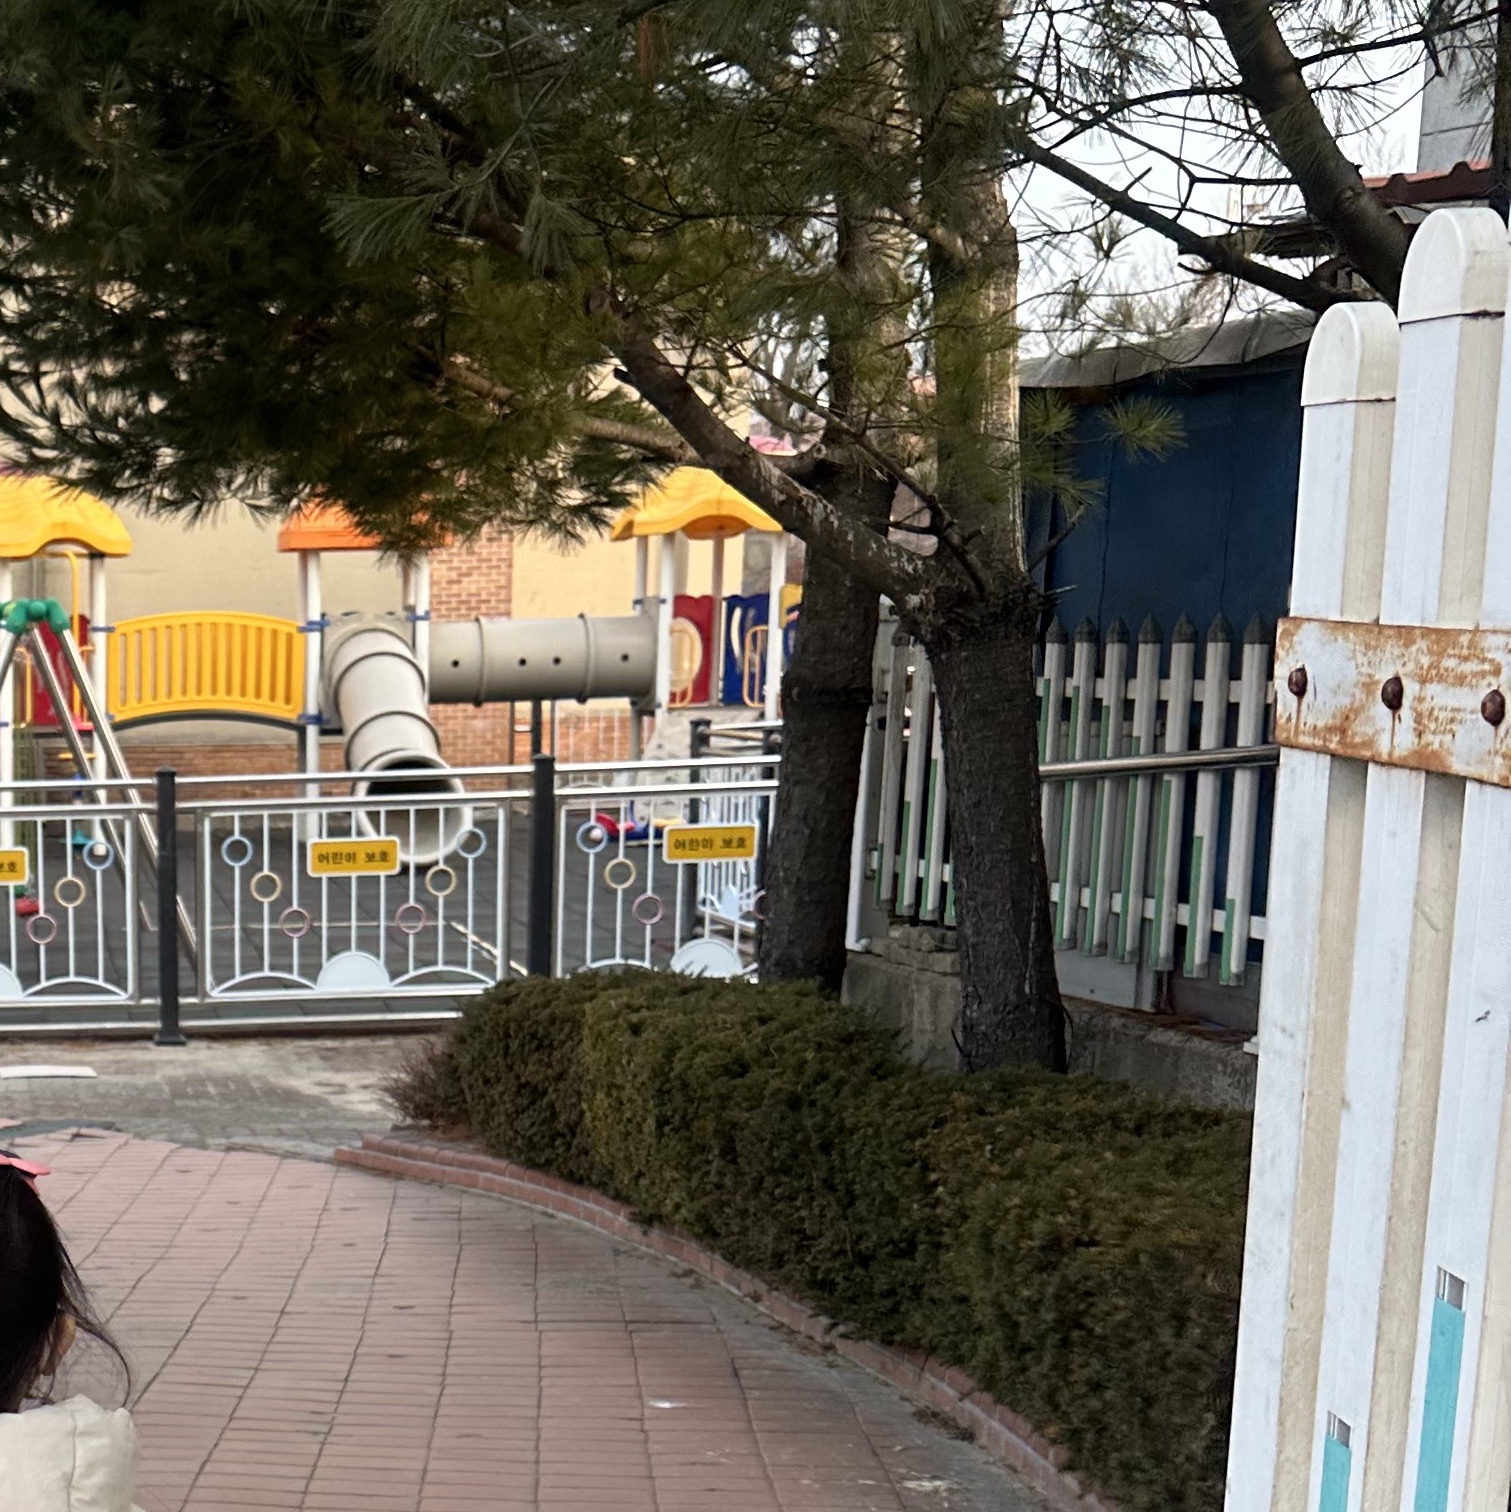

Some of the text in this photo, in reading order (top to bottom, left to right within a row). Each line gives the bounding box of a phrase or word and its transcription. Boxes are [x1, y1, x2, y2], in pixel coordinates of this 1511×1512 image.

[674, 837, 747, 852] 어린이 보호
[318, 850, 390, 865] 어린이 보호
